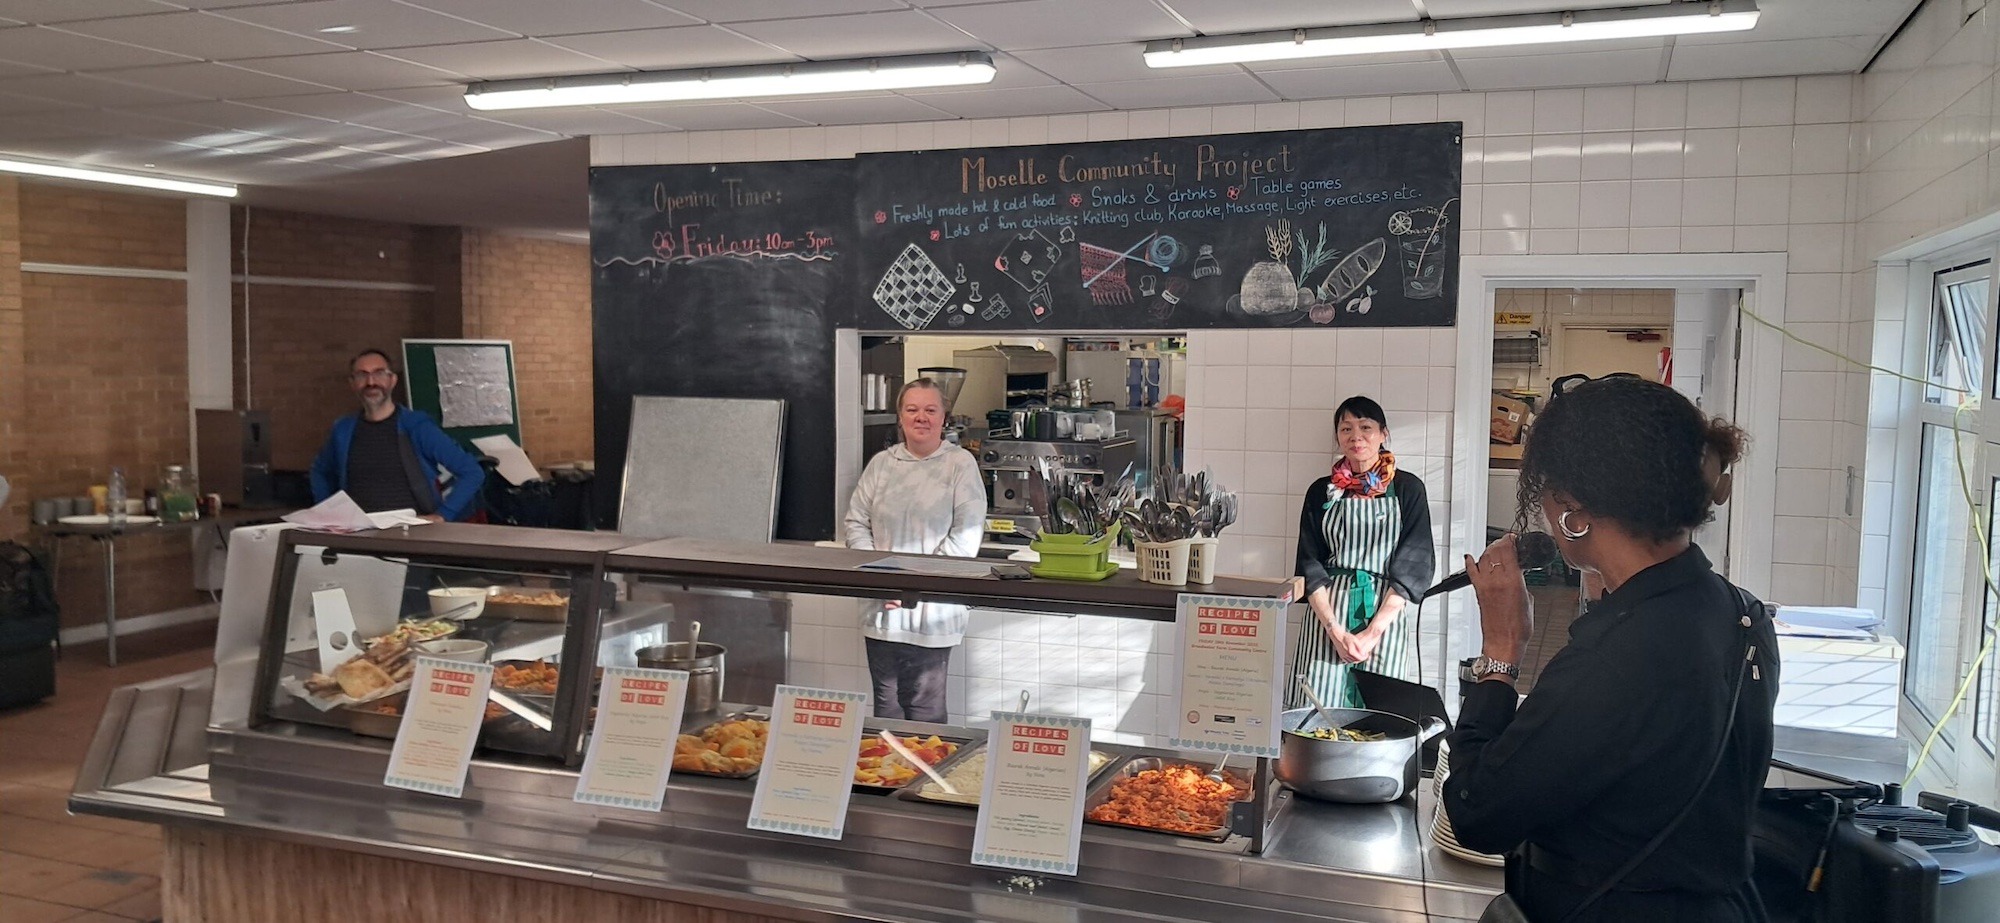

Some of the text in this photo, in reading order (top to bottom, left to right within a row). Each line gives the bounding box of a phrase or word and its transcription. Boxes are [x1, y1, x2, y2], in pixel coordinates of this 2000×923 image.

[962, 144, 1295, 193] Moselle Community Project
[722, 178, 782, 207] Time:
[893, 204, 933, 225] Freshly
[938, 206, 968, 216] made
[972, 201, 988, 214] hot
[1003, 197, 1027, 211] cold
[1032, 193, 1056, 207] food
[1091, 185, 1136, 207] Snaks
[1144, 183, 1160, 204] &
[1168, 186, 1217, 202] drinks
[1251, 176, 1294, 196] Table
[1300, 178, 1342, 198] games
[944, 221, 971, 240] Lots
[978, 217, 990, 233] of
[999, 216, 1017, 230] fun
[1021, 213, 1079, 230] activities:
[1082, 210, 1129, 228] Knitting
[1134, 209, 1164, 224] club,
[1168, 203, 1225, 222] Karaoke,
[1226, 202, 1283, 217] Massage,
[1286, 197, 1316, 215] Light
[682, 224, 760, 256] Friday:
[1199, 607, 1259, 620] RECIPES
[1200, 623, 1256, 636] OF LOVE
[795, 700, 845, 712] RECIPES
[795, 714, 841, 726] OF LOVE
[1013, 727, 1068, 739] RECIPES
[1013, 742, 1065, 754] OF LOVE
